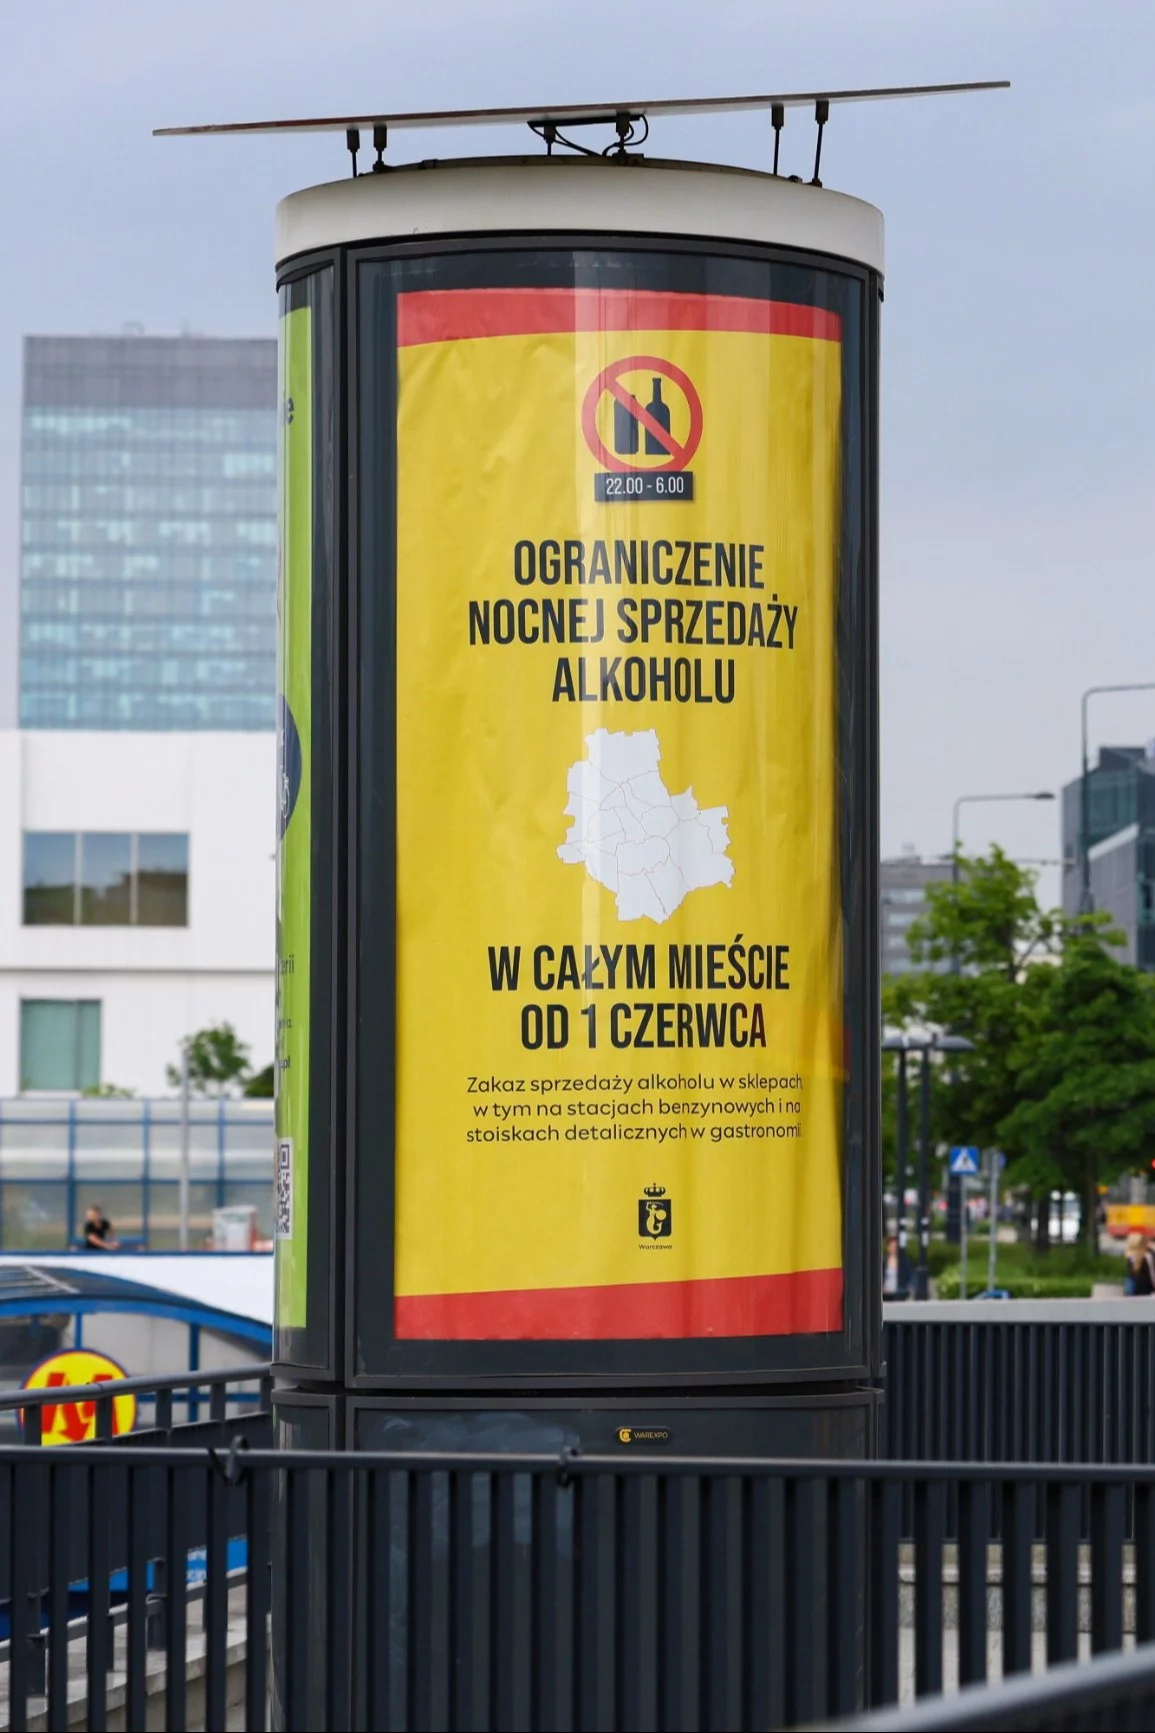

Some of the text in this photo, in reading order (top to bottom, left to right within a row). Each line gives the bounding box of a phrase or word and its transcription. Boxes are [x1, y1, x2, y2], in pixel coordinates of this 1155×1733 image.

[605, 477, 643, 495] 22.00
[656, 476, 684, 494] 6.00
[513, 540, 765, 589] OGRANICZENIE
[468, 593, 798, 650] NOCNEJ SPRZEDAŻY
[552, 656, 735, 704] ALKOHOLU
[488, 934, 790, 991] W CAŁYM MIEŚCIE
[521, 1003, 767, 1050] OD 1 CZERWCA
[467, 1075, 525, 1094] Zakaz
[530, 1075, 633, 1095] sprzedaży
[638, 1073, 714, 1090] alkoholu
[720, 1078, 735, 1090] w
[474, 1098, 801, 1121] w tym na stacjach benzynowych i na
[466, 1124, 560, 1142] stoiskach
[565, 1122, 687, 1143] detalicznych
[690, 1126, 705, 1138] w
[634, 1431, 668, 1439] WAREXPO
